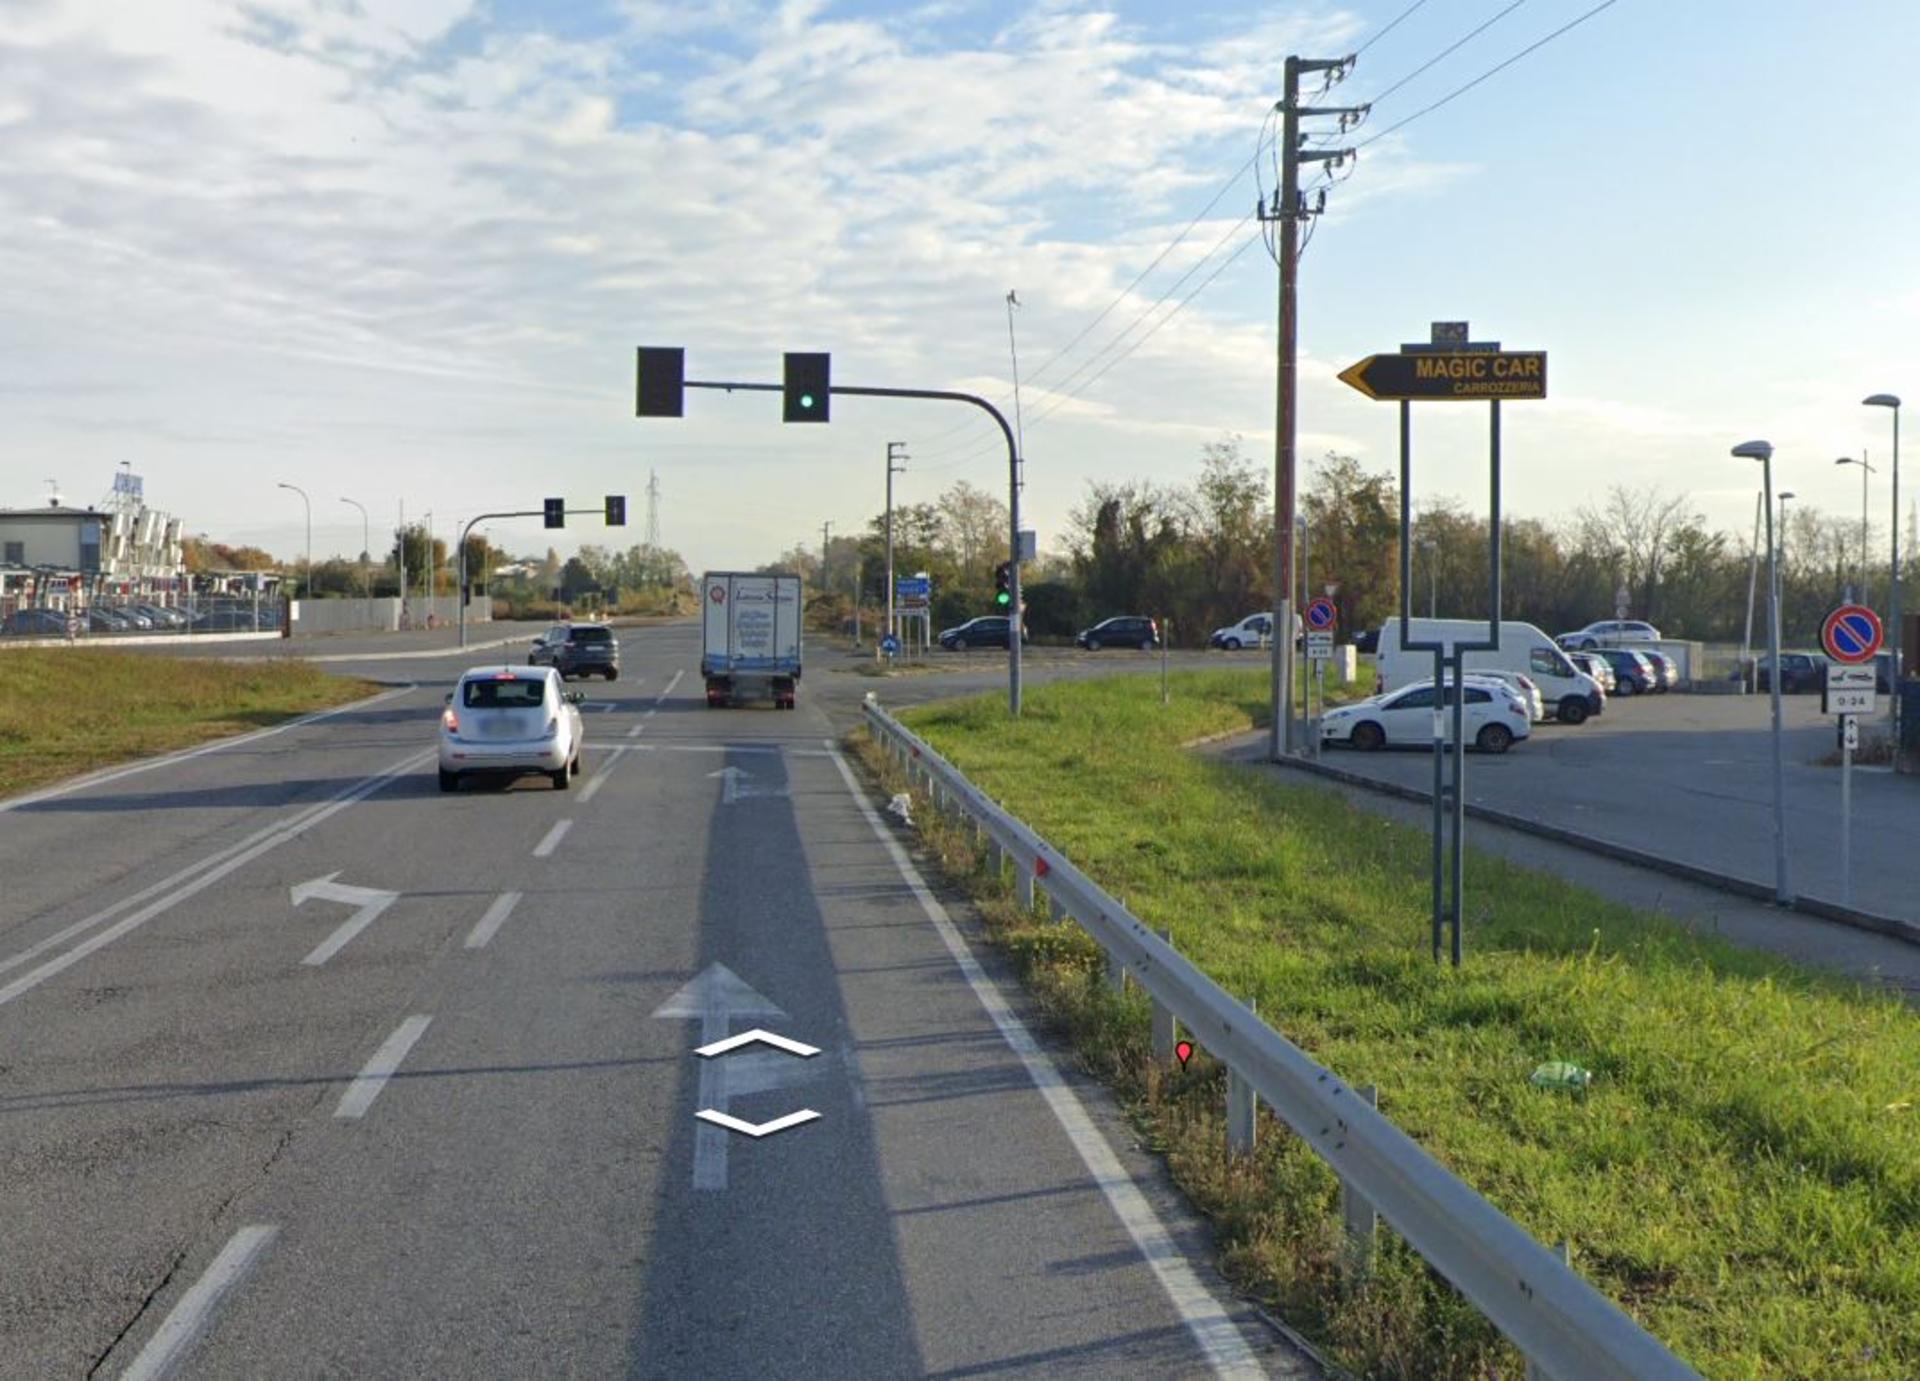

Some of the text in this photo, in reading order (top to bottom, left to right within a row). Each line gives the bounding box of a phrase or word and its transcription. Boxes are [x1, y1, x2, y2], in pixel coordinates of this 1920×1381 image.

[1416, 357, 1539, 378] MAGIC CAR
[1454, 381, 1540, 394] CARROZZERIA
